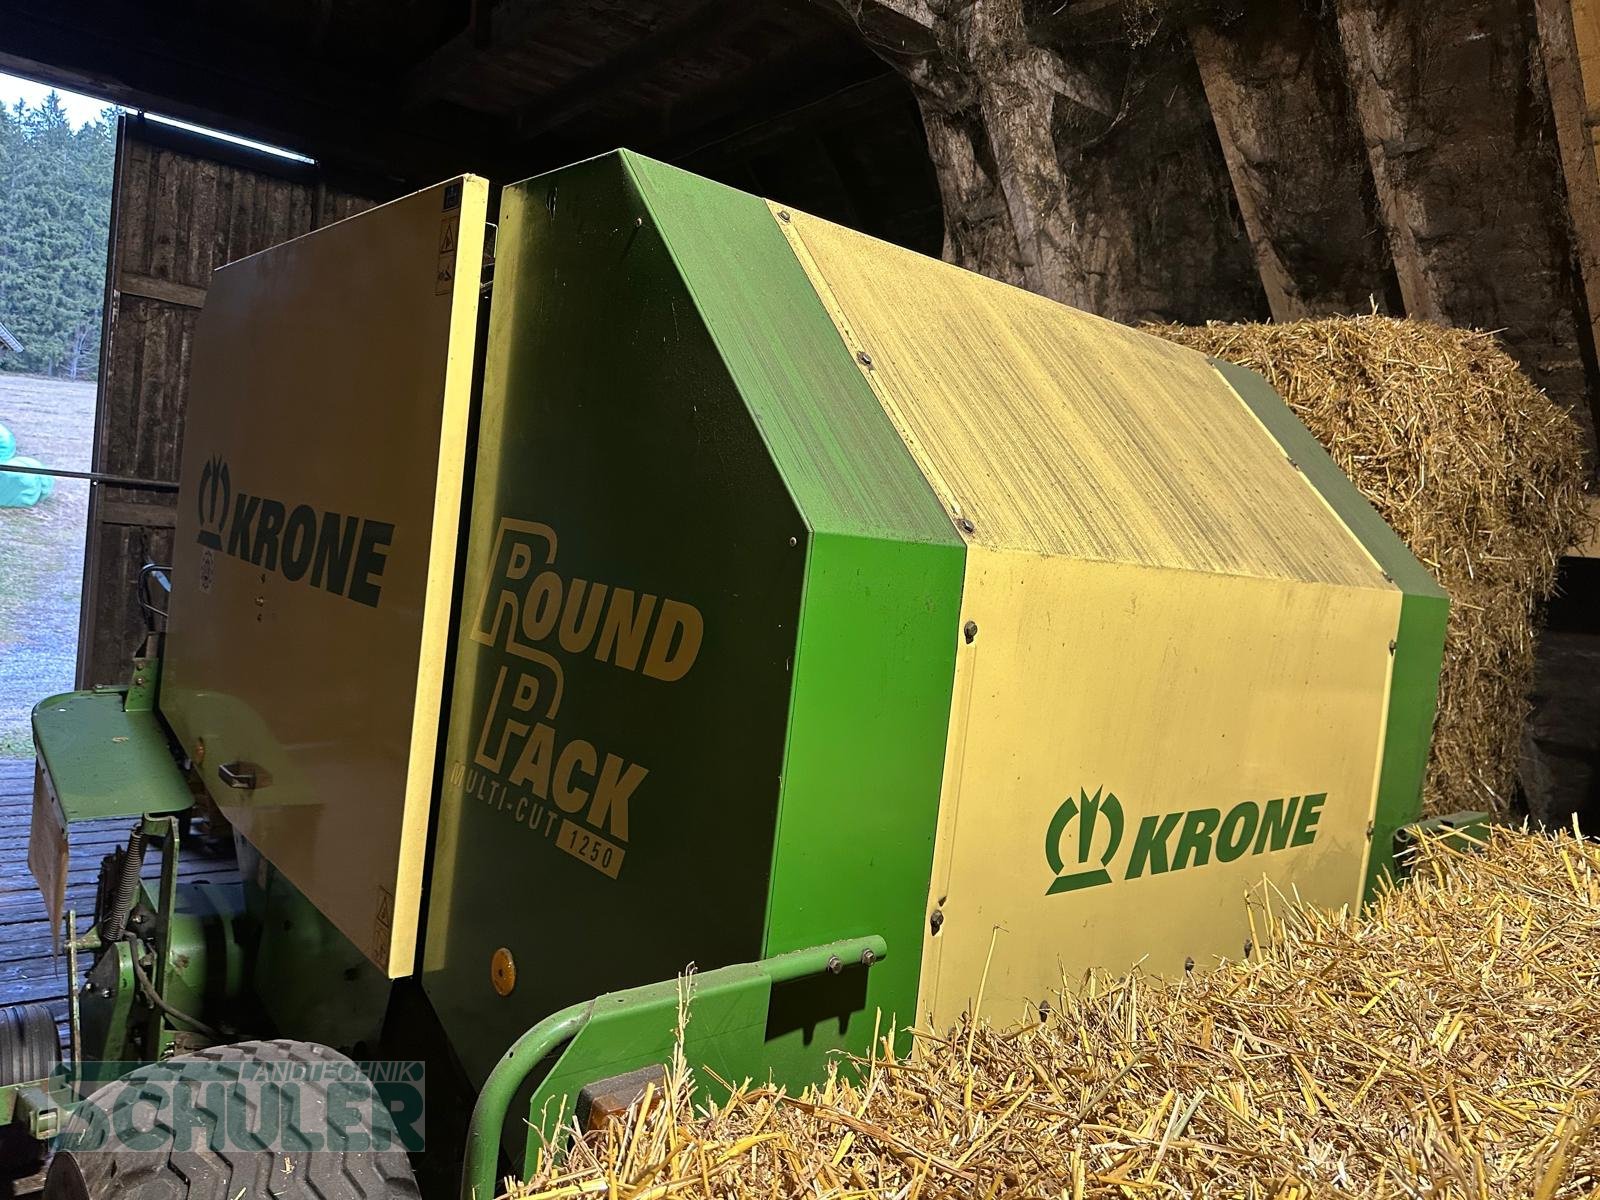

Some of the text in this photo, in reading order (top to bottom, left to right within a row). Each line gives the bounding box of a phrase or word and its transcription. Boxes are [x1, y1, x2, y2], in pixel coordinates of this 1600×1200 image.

[227, 492, 395, 608] KRONE
[469, 517, 704, 682] ROUND
[474, 652, 649, 842] PACK
[450, 760, 614, 869] MULTI-CUT 1250
[1124, 792, 1328, 880] KRONE
